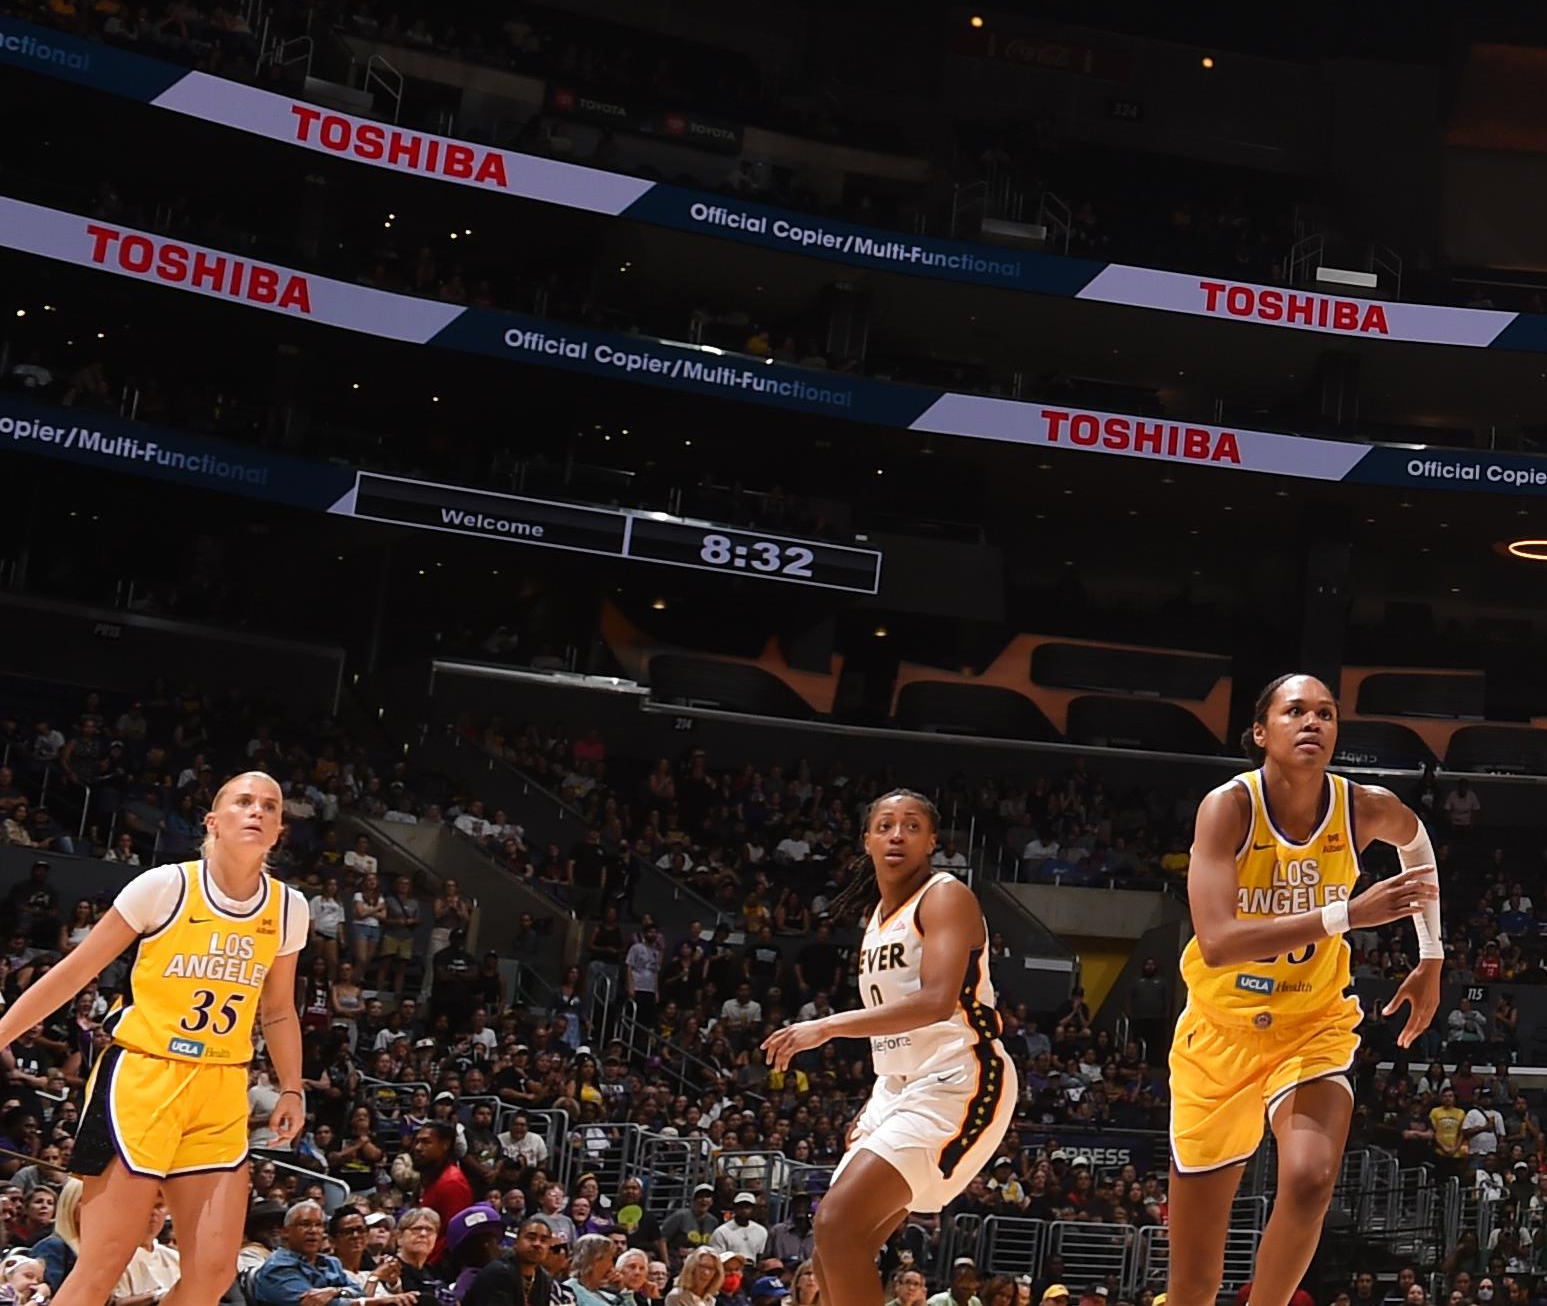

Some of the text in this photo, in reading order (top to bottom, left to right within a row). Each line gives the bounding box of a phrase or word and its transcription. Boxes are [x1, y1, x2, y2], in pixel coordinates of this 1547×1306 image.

[578, 97, 629, 118] TOYOTA
[291, 104, 509, 188] TOSHIBA
[690, 121, 737, 141] TOYOTA
[689, 201, 1022, 278] Official Copier/Multi-Functional
[86, 224, 312, 314] TOSHIBA
[1200, 280, 1390, 335] TOSHIBA
[503, 327, 856, 409] Official Copier/Multi-Functional
[1041, 410, 1242, 464] TOSHIBA
[1406, 458, 1482, 481] Official
[440, 507, 816, 578] Welcome 8:32
[1272, 858, 1320, 887] LOS
[209, 932, 256, 958] LOS
[163, 952, 268, 989] ANGELE
[1240, 975, 1313, 994] UCLA Health
[180, 989, 245, 1036] 35
[1467, 987, 1485, 1002] 115
[170, 1037, 200, 1055] UCLA
